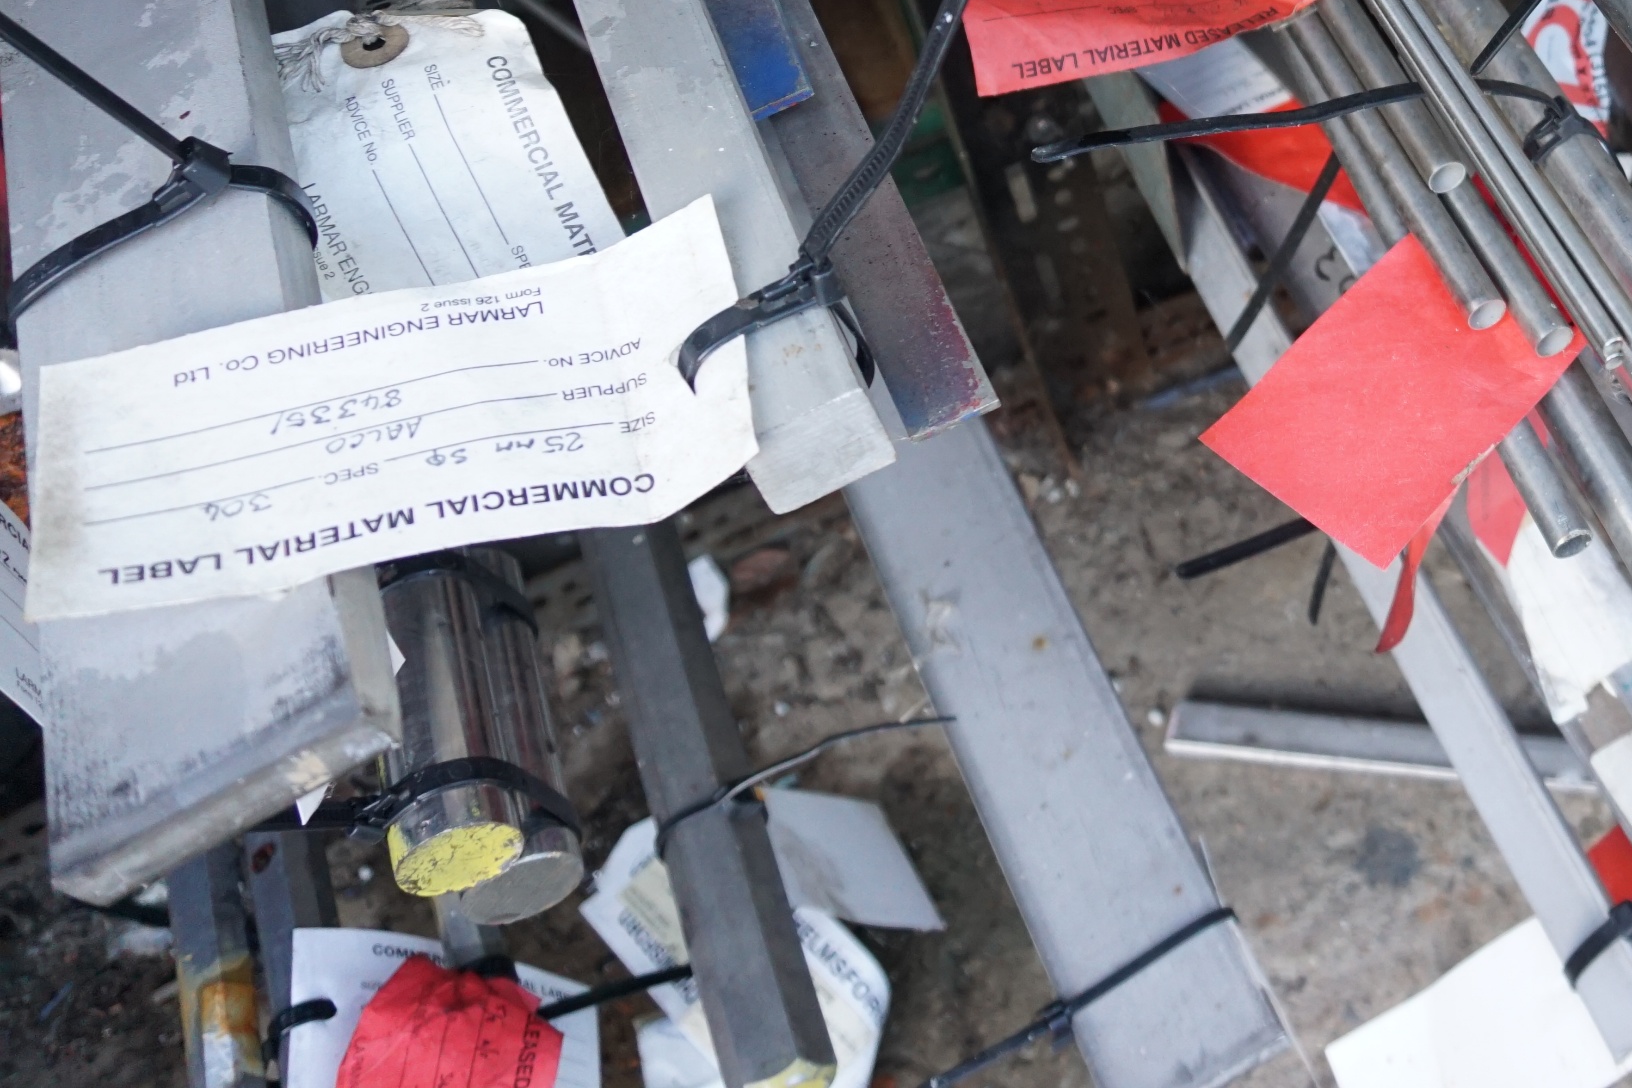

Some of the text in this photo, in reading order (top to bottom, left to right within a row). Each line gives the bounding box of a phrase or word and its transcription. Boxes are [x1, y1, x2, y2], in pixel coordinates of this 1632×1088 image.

[1011, 4, 1278, 80] RELEASED MATERIAL LABEL
[423, 63, 445, 92] SIZE
[344, 95, 378, 166] ADVICE No.
[380, 78, 417, 142] SUPPLIER
[485, 55, 565, 201] COMMERCIAL
[302, 182, 350, 256] LARMAR
[313, 245, 337, 280] ssue 2
[509, 244, 532, 270] SPE
[420, 286, 542, 313] Form 126 issue 2
[172, 300, 545, 388] LARMAR ENGINEERING Co. Ltd
[543, 337, 642, 368] ADVICE No.
[561, 372, 648, 401] SUPPLIER
[619, 410, 657, 434] SIZE
[317, 461, 380, 486] SPEC.
[97, 472, 656, 586] COMMERCIAL MATERIAL LABEL
[512, 1014, 541, 1088] LEASED
